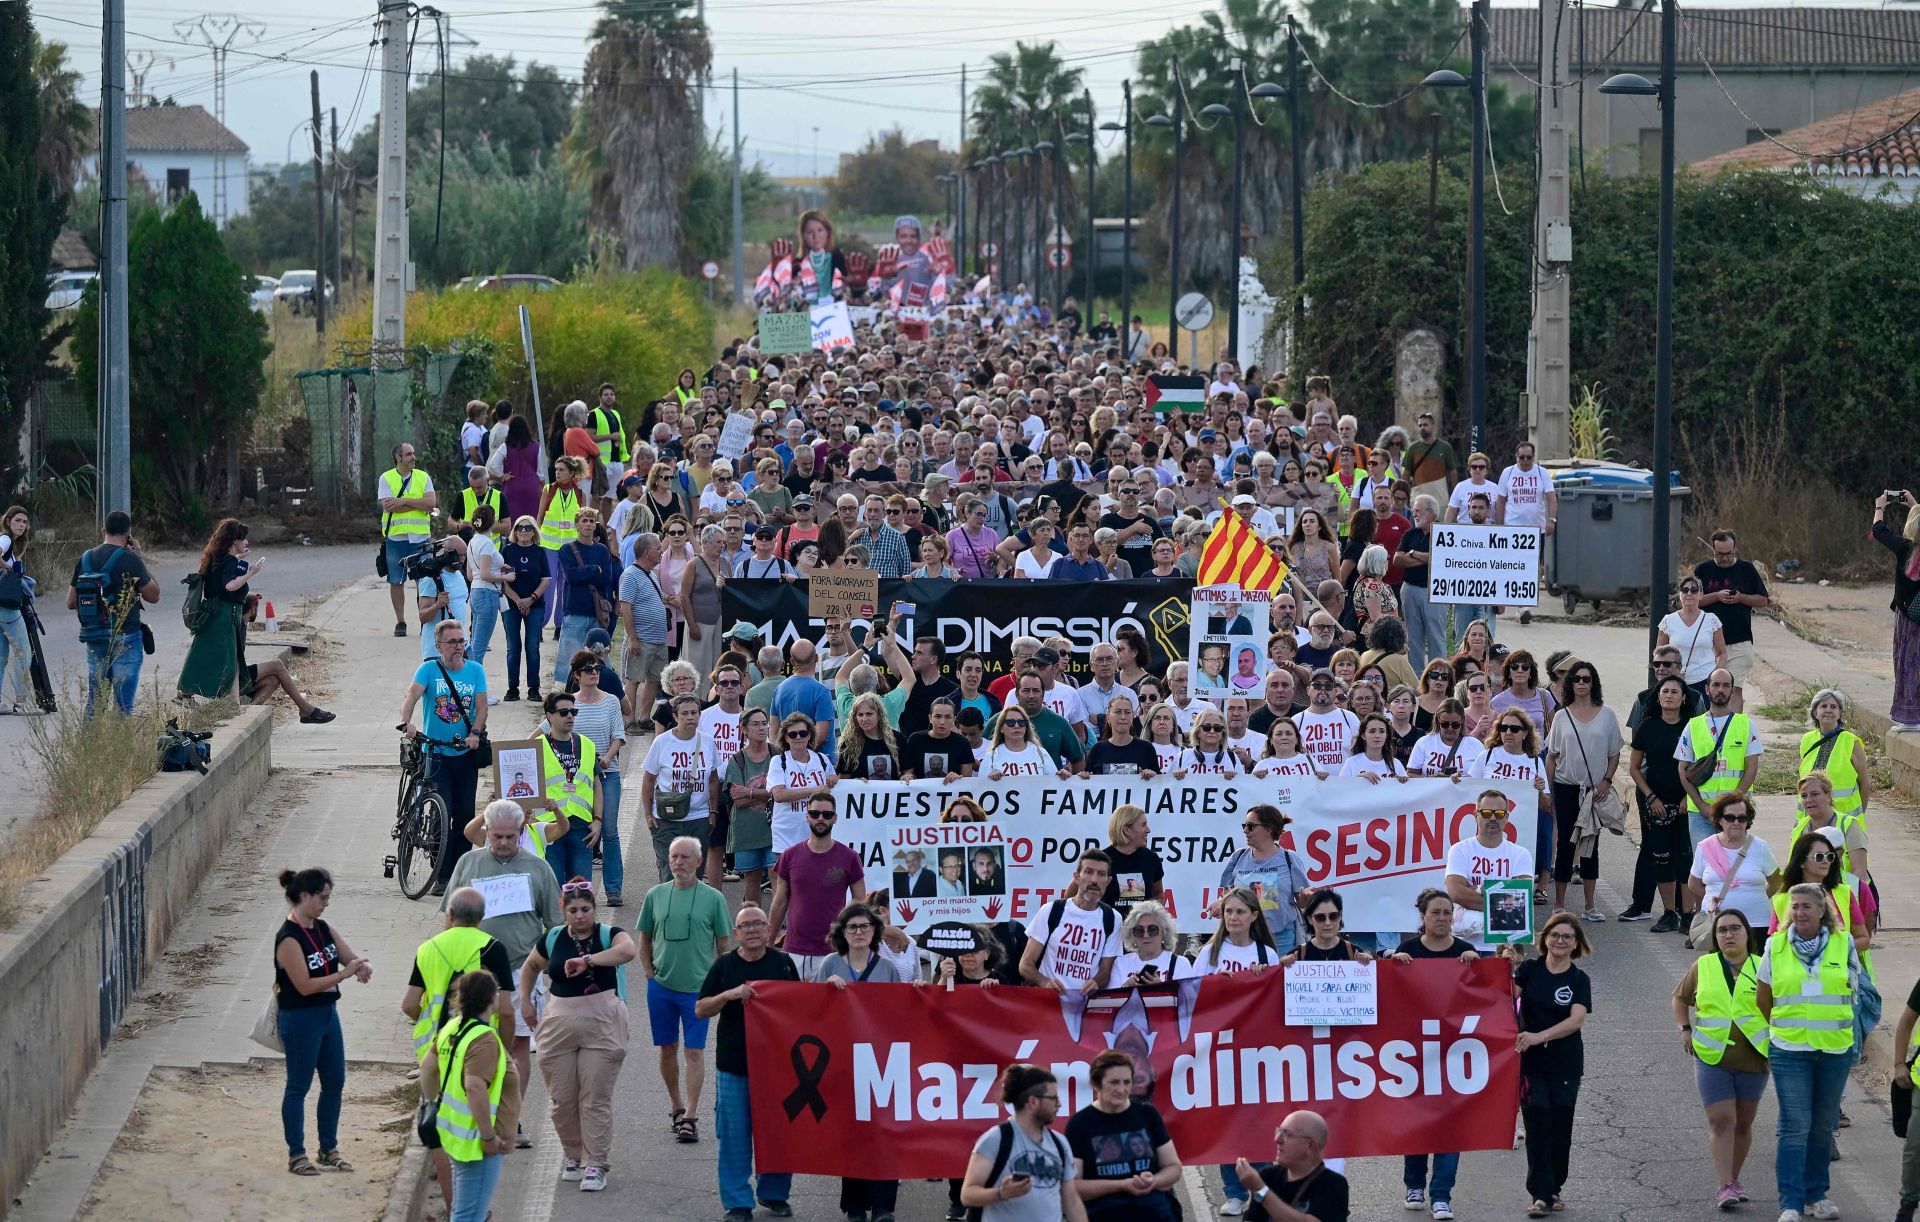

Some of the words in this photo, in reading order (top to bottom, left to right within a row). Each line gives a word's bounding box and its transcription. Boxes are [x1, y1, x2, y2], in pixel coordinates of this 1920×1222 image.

[1511, 476, 1537, 487] 20:11
[1519, 487, 1537, 496] OBLIT
[1435, 531, 1458, 548] A3.
[1460, 538, 1486, 549] Chiva.
[1489, 533, 1508, 549] Km
[1511, 533, 1536, 550] 322
[1445, 558, 1487, 570] Dirección
[1490, 560, 1526, 571] Valencia
[811, 575, 831, 586] FORA
[1432, 578, 1497, 598] 29/10/2024
[1504, 581, 1536, 599] 19:50
[814, 589, 835, 599] DEL
[837, 590, 873, 602] CONSELL
[1192, 590, 1227, 602] VICTIMAS
[825, 604, 840, 615] 228
[937, 601, 1146, 653] DIMISSIÓ
[713, 722, 742, 740] 20:1
[1305, 722, 1343, 741] 20:11
[1305, 743, 1316, 755] NI
[1317, 741, 1343, 752] OBLIT
[671, 751, 706, 768] 20:1
[1317, 752, 1343, 765] PERDÓ
[1427, 751, 1463, 769] 2011
[672, 770, 681, 780] NI
[1001, 761, 1040, 777] 20:11
[1493, 761, 1531, 780] 20:11
[789, 770, 824, 788] 20:11
[845, 788, 1021, 819] NUESTOS
[1040, 787, 1239, 816] FAMILIARES
[891, 824, 1005, 846] JUSTICIA
[1471, 855, 1510, 878] 20:11
[922, 899, 935, 907] por
[949, 897, 977, 905] marido
[951, 906, 971, 915] hijos
[932, 928, 972, 939] MAZÓN
[1059, 922, 1102, 950] 20:11
[926, 938, 976, 950] DIMISSIÓ
[1056, 945, 1069, 961] NI
[1054, 960, 1065, 976] NI
[1065, 963, 1091, 981] PERD
[1294, 964, 1346, 979] JUSTICIA
[1286, 982, 1312, 992] MIGUEL
[1321, 982, 1342, 992] SARA
[1345, 981, 1372, 993] CARPIO
[1296, 1007, 1320, 1015] TODAS
[1325, 1007, 1337, 1015] LAS
[853, 1039, 1094, 1122] Mazn
[1171, 1015, 1490, 1110] dimissió
[1096, 1161, 1131, 1177] ELVIRA
